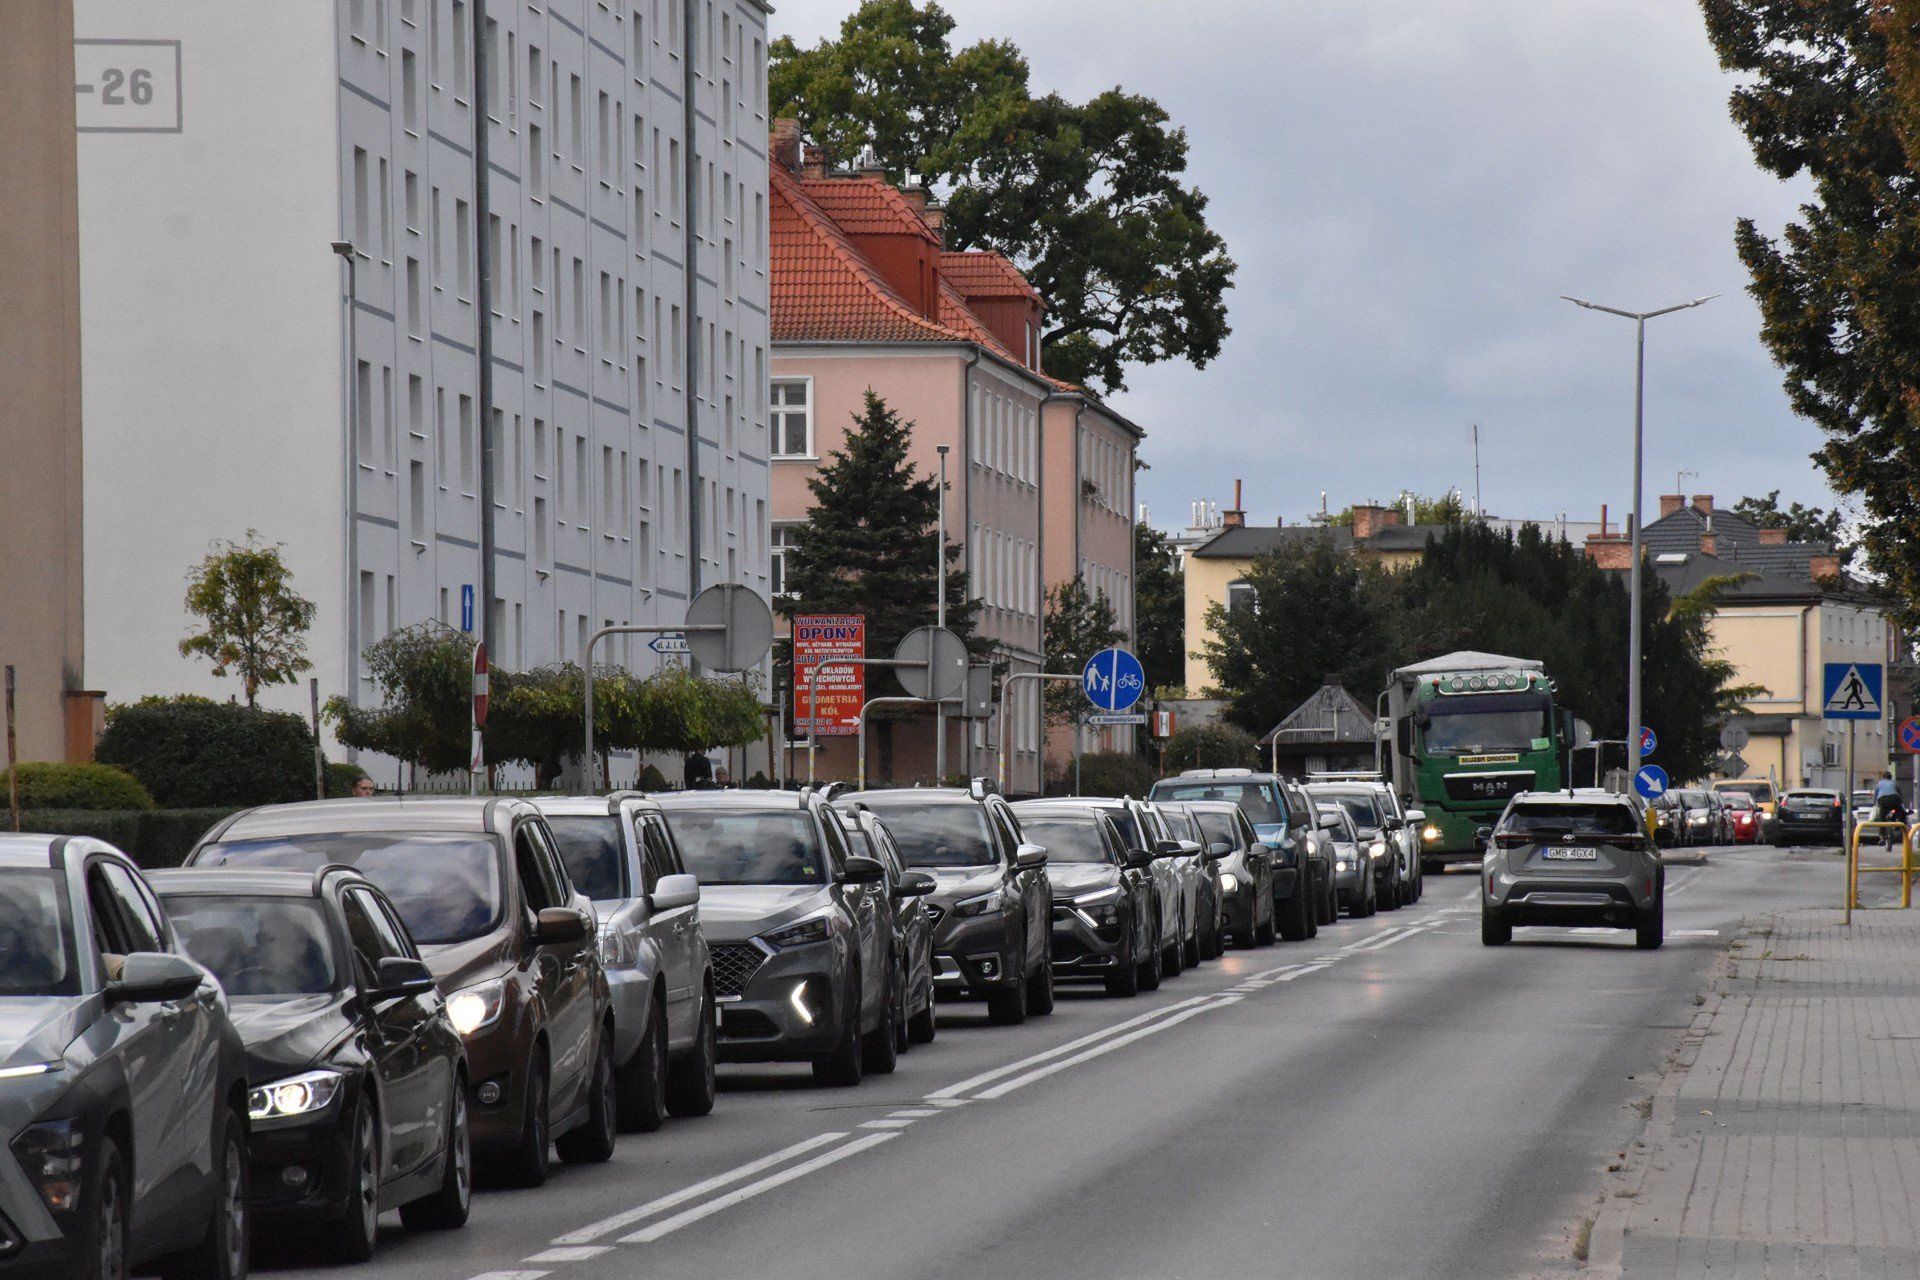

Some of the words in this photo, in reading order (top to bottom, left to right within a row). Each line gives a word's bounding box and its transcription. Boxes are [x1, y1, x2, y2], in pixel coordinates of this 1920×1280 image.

[796, 617, 862, 625] WULKANIZACJA
[799, 627, 859, 640] OPONY
[796, 655, 816, 665] AUTO
[821, 664, 854, 675] UKŁADÓW
[820, 704, 840, 715] KÓŁ
[1472, 781, 1508, 791] MAN
[1549, 848, 1568, 858] GMB
[1570, 848, 1594, 858] 4GX4
